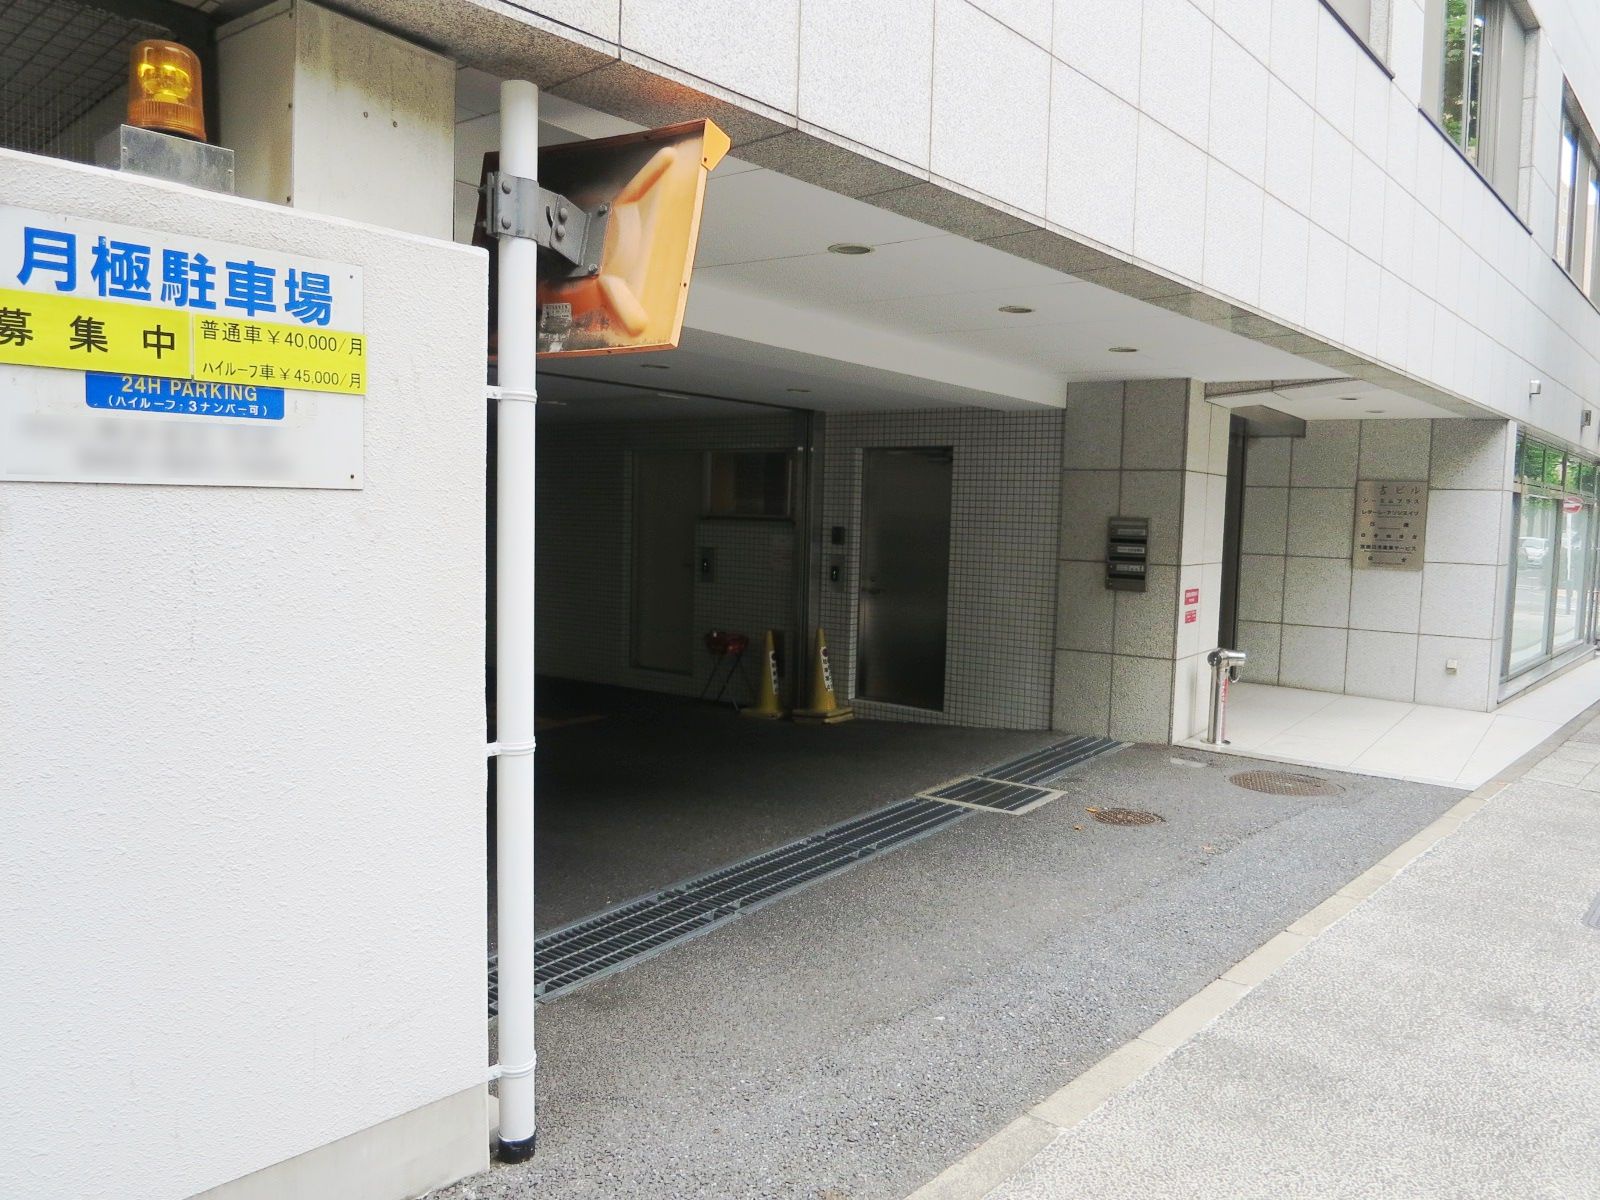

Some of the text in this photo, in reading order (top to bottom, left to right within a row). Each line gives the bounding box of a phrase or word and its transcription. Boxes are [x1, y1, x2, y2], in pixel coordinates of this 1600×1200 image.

[17, 227, 333, 325] 月極駐車場
[0, 306, 175, 359] 募集中
[121, 375, 257, 401] 24H PARKING
